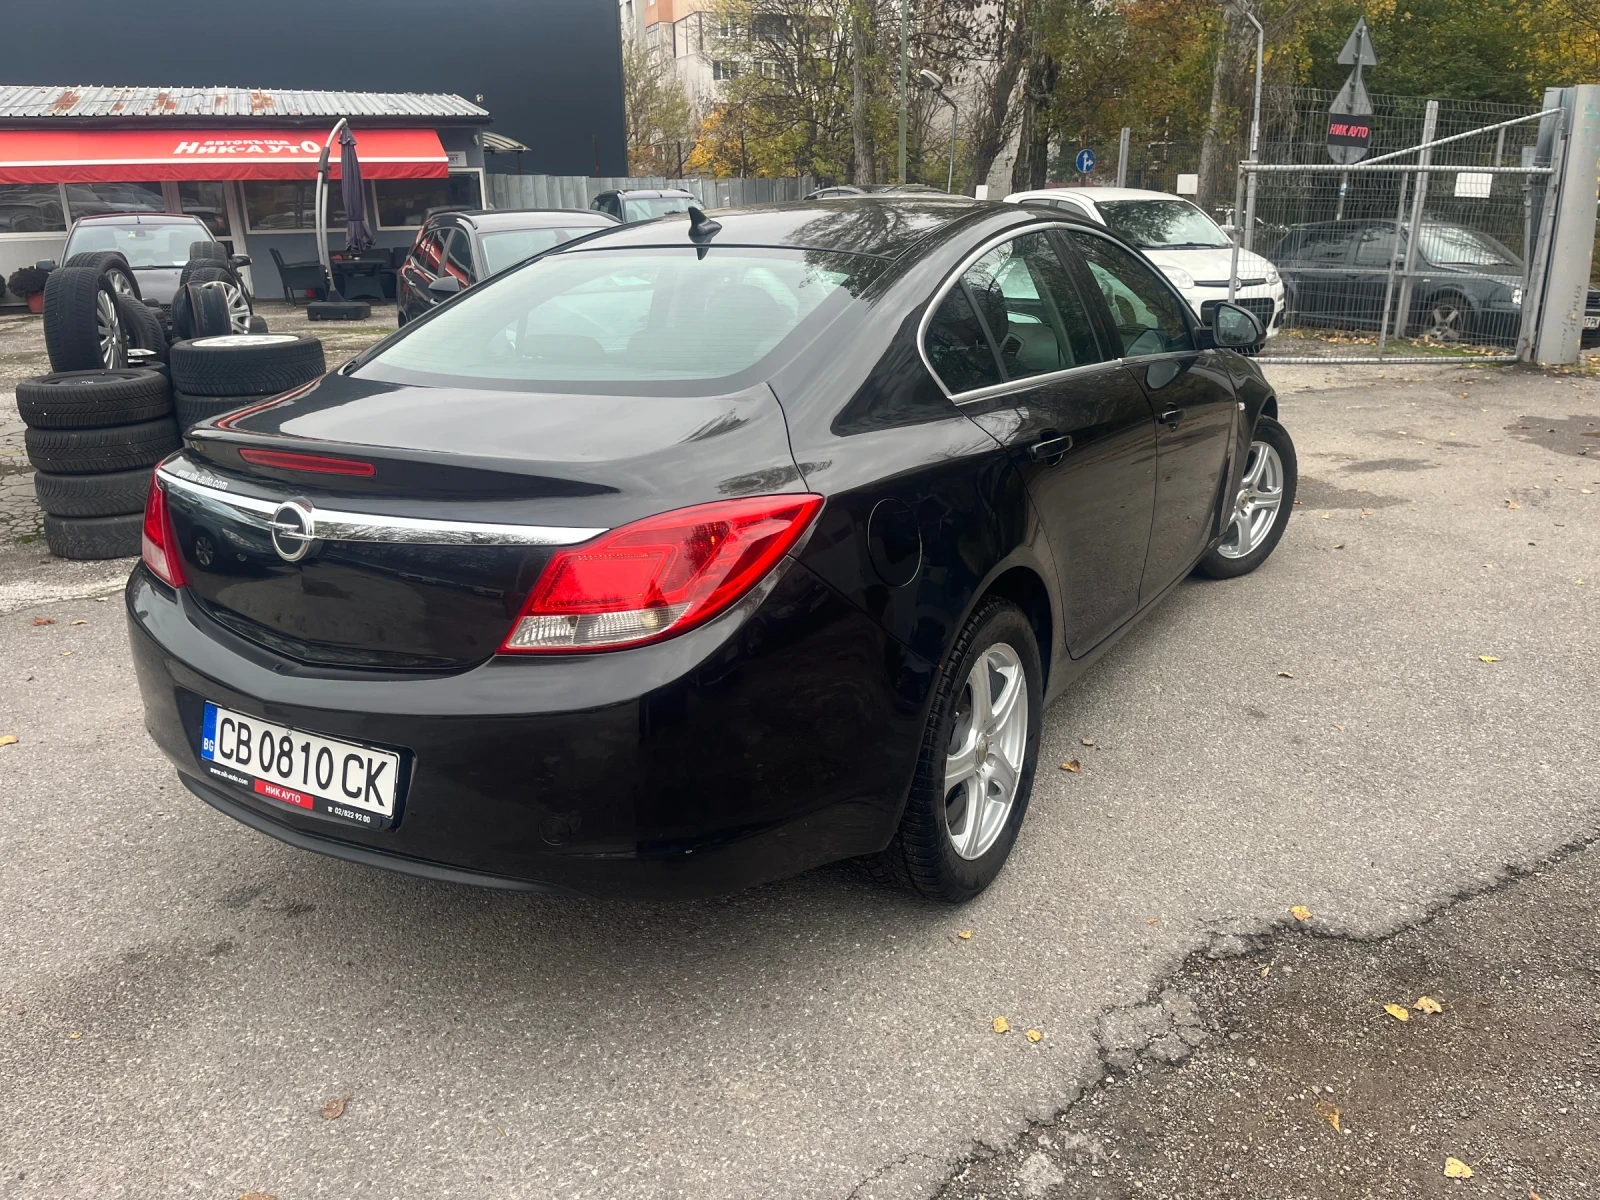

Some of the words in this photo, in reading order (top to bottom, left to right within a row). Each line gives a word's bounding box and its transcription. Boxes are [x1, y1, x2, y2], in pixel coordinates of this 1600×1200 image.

[1329, 123, 1348, 135] НИК
[1348, 126, 1368, 138] АУТО
[176, 469, 228, 490] www.nik-auto.com
[203, 737, 215, 752] BG
[258, 730, 334, 791] 0810
[265, 784, 281, 797] НИК
[281, 790, 302, 803] АУТО
